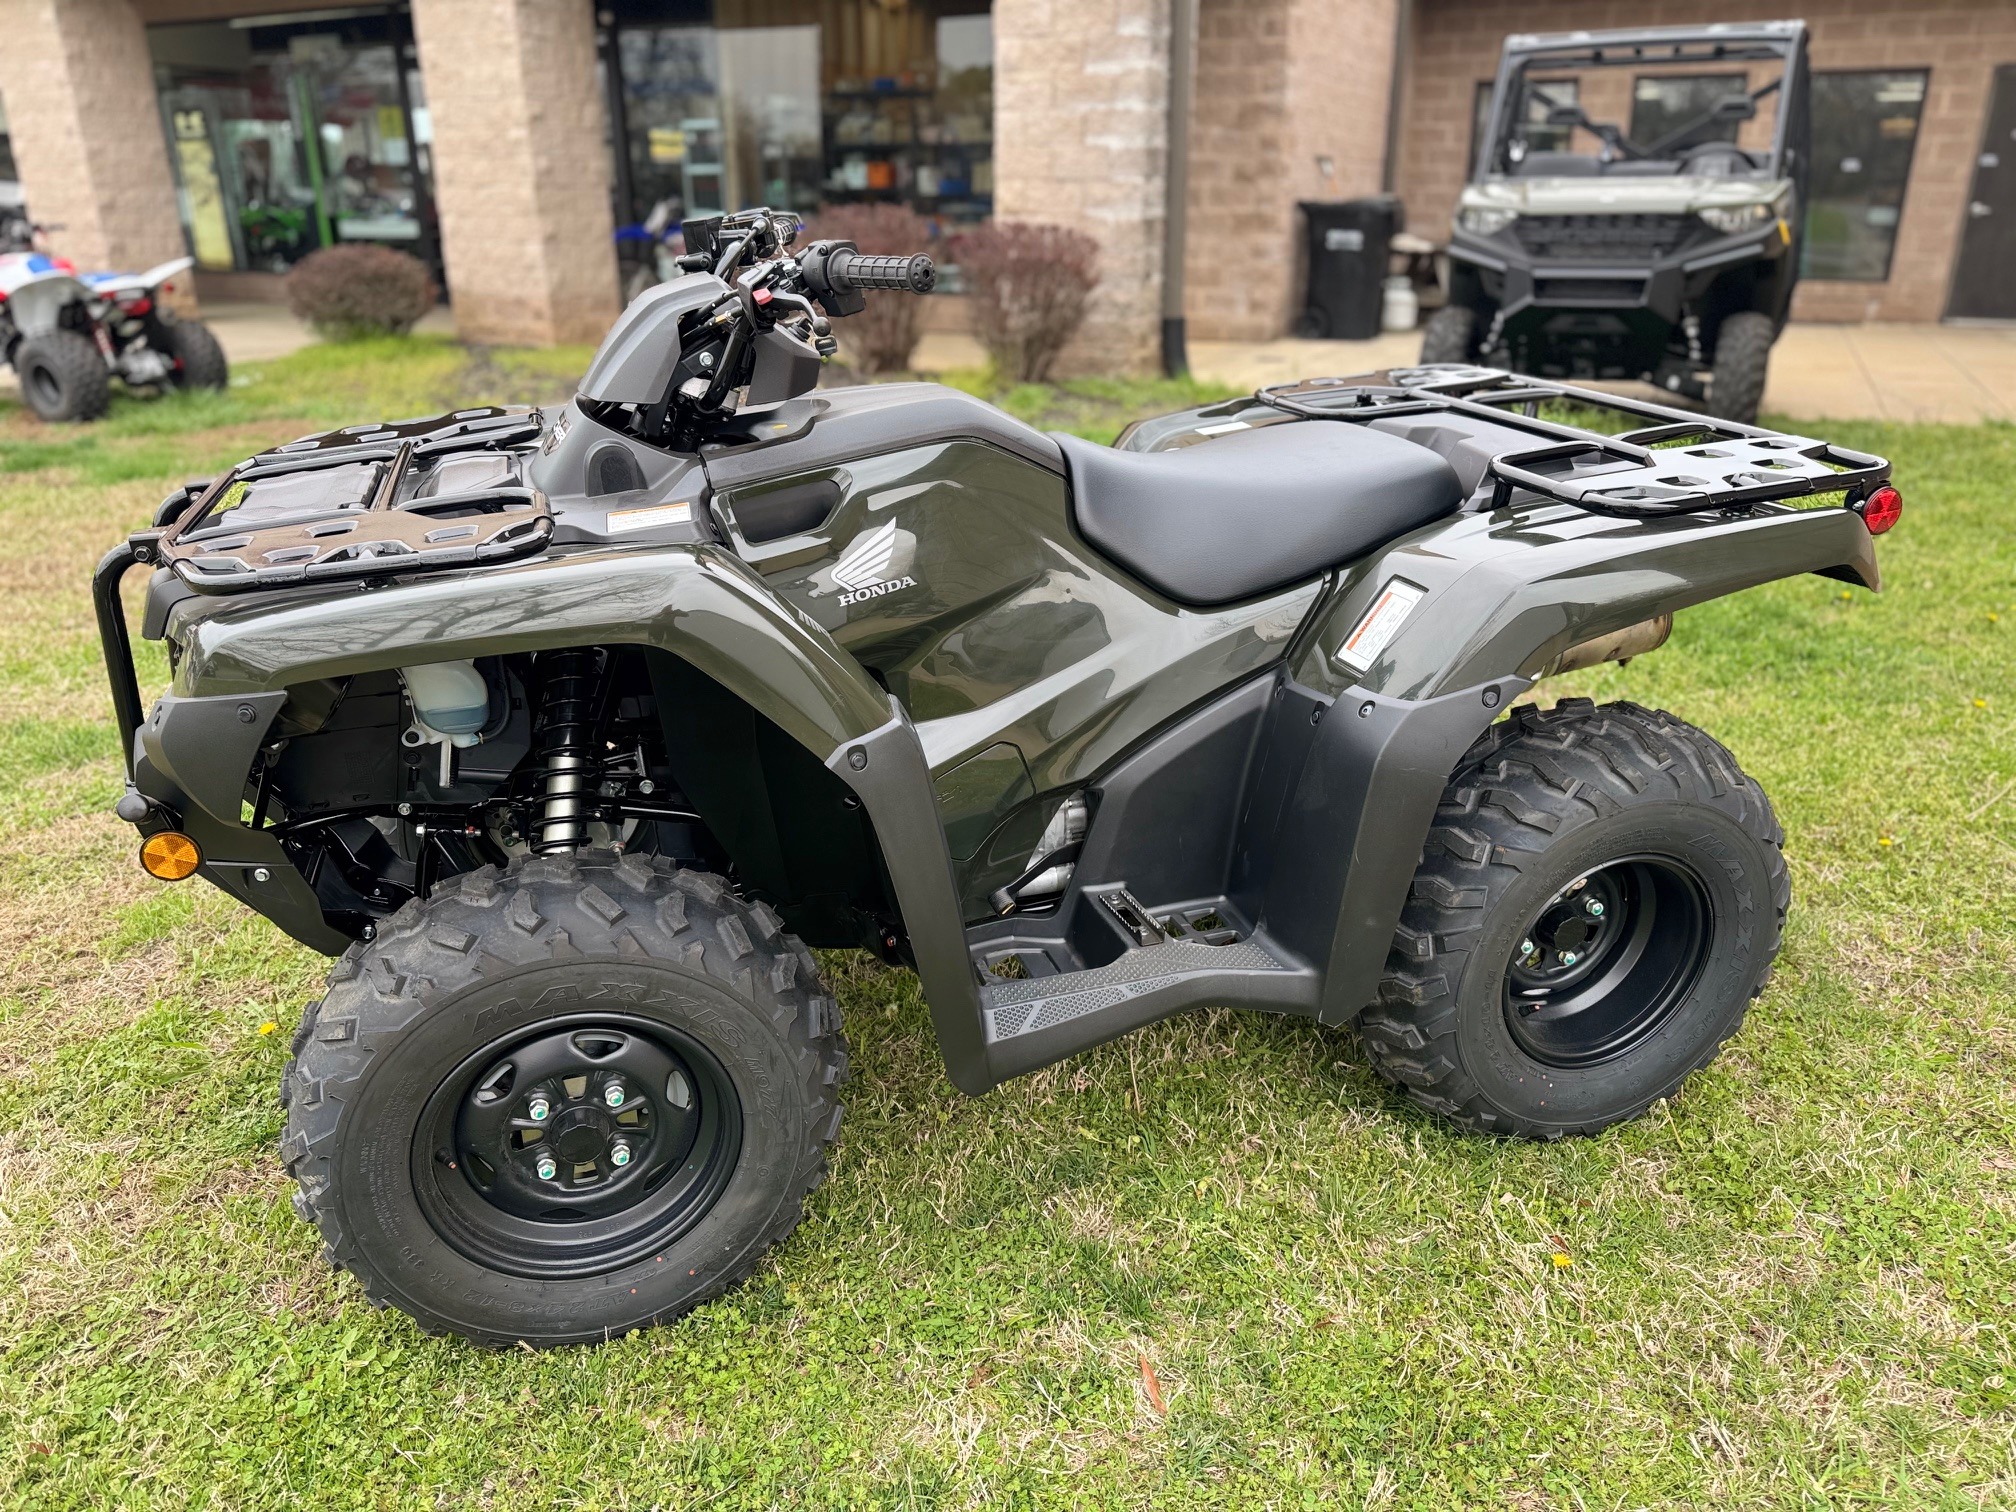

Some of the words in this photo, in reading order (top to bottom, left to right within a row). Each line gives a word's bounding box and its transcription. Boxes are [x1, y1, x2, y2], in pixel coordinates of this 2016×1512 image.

[837, 576, 918, 607] HONDA
[1686, 832, 1755, 1001] MAXXIS
[472, 981, 749, 1048] MAXXIS
